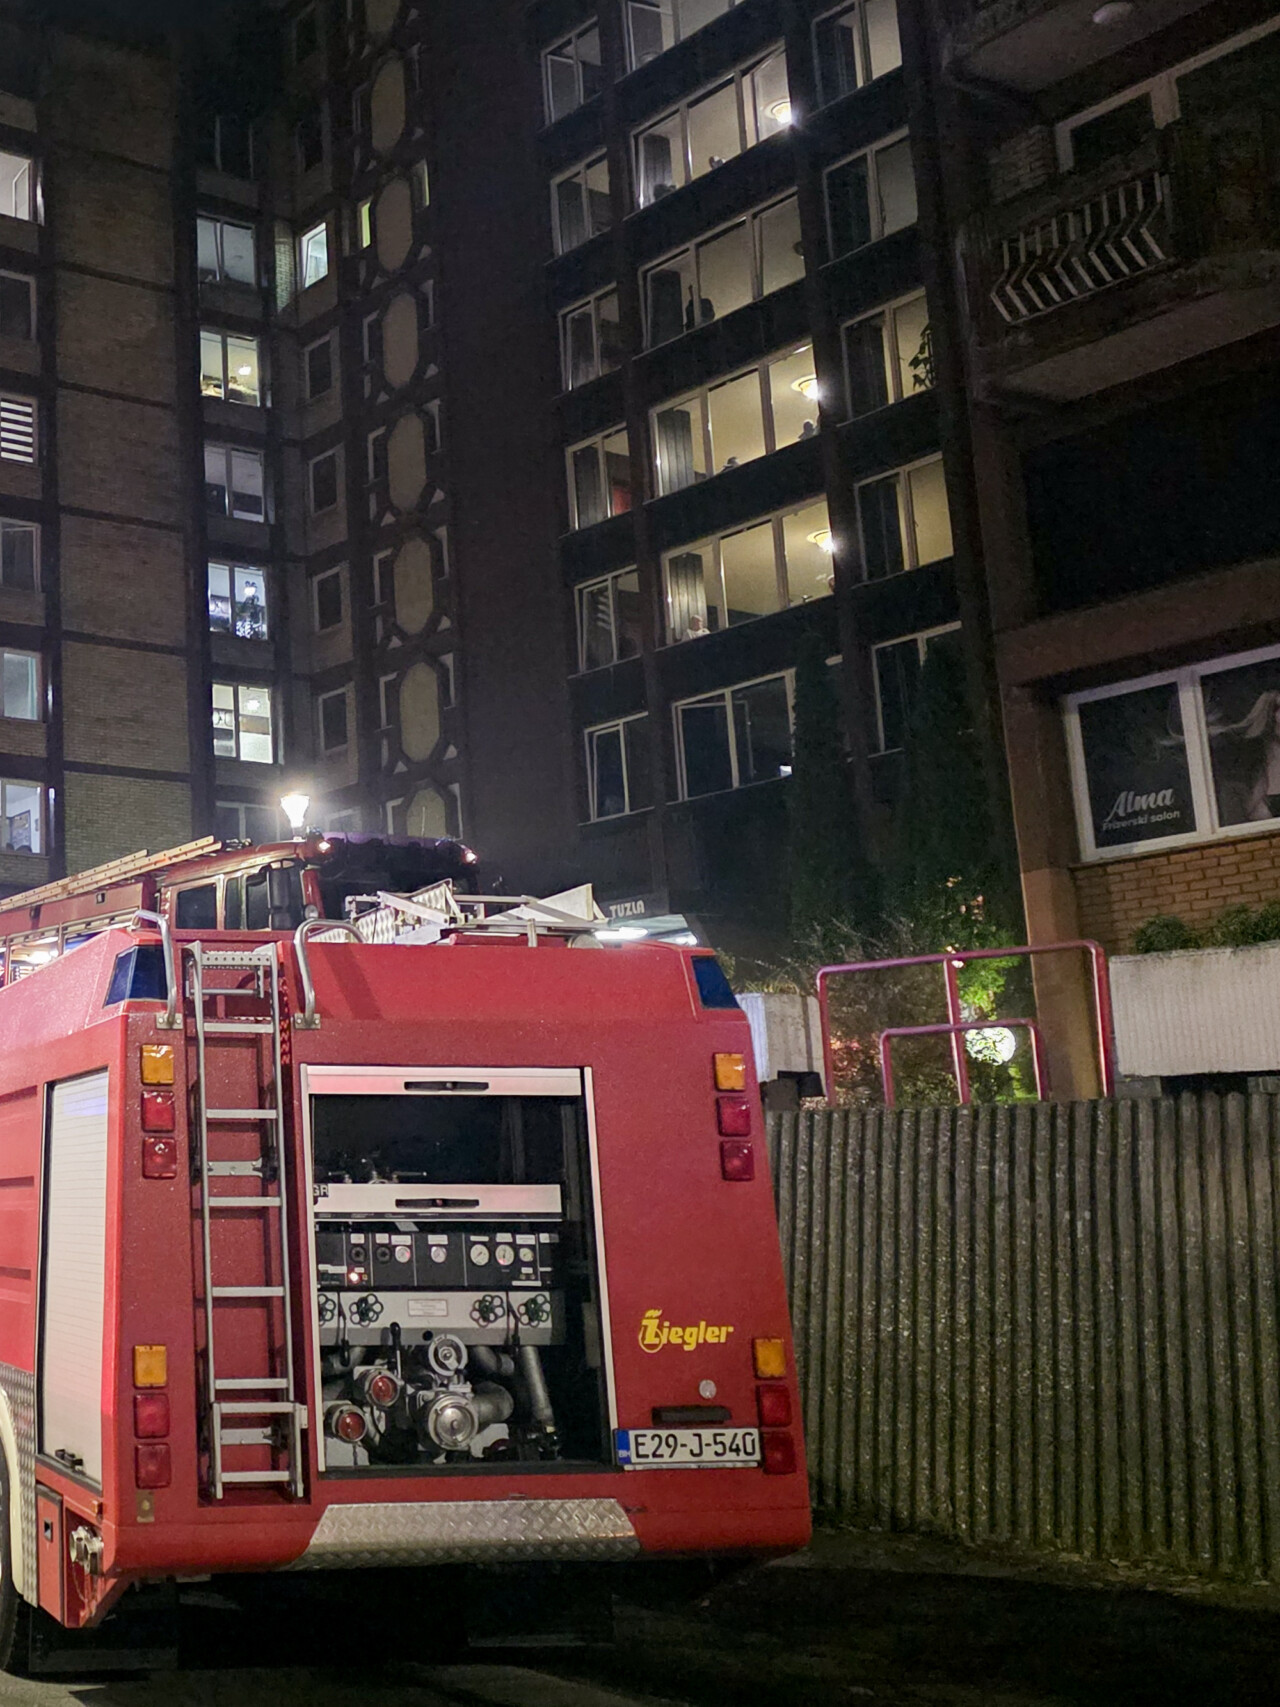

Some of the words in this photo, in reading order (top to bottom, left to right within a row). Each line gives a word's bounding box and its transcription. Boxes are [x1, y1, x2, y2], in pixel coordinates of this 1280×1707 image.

[1106, 788, 1174, 821] Alma
[1150, 810, 1180, 823] salon
[609, 900, 645, 919] TUZLA
[638, 1309, 735, 1354] Ziegler
[634, 1432, 756, 1459] E29-J-540
